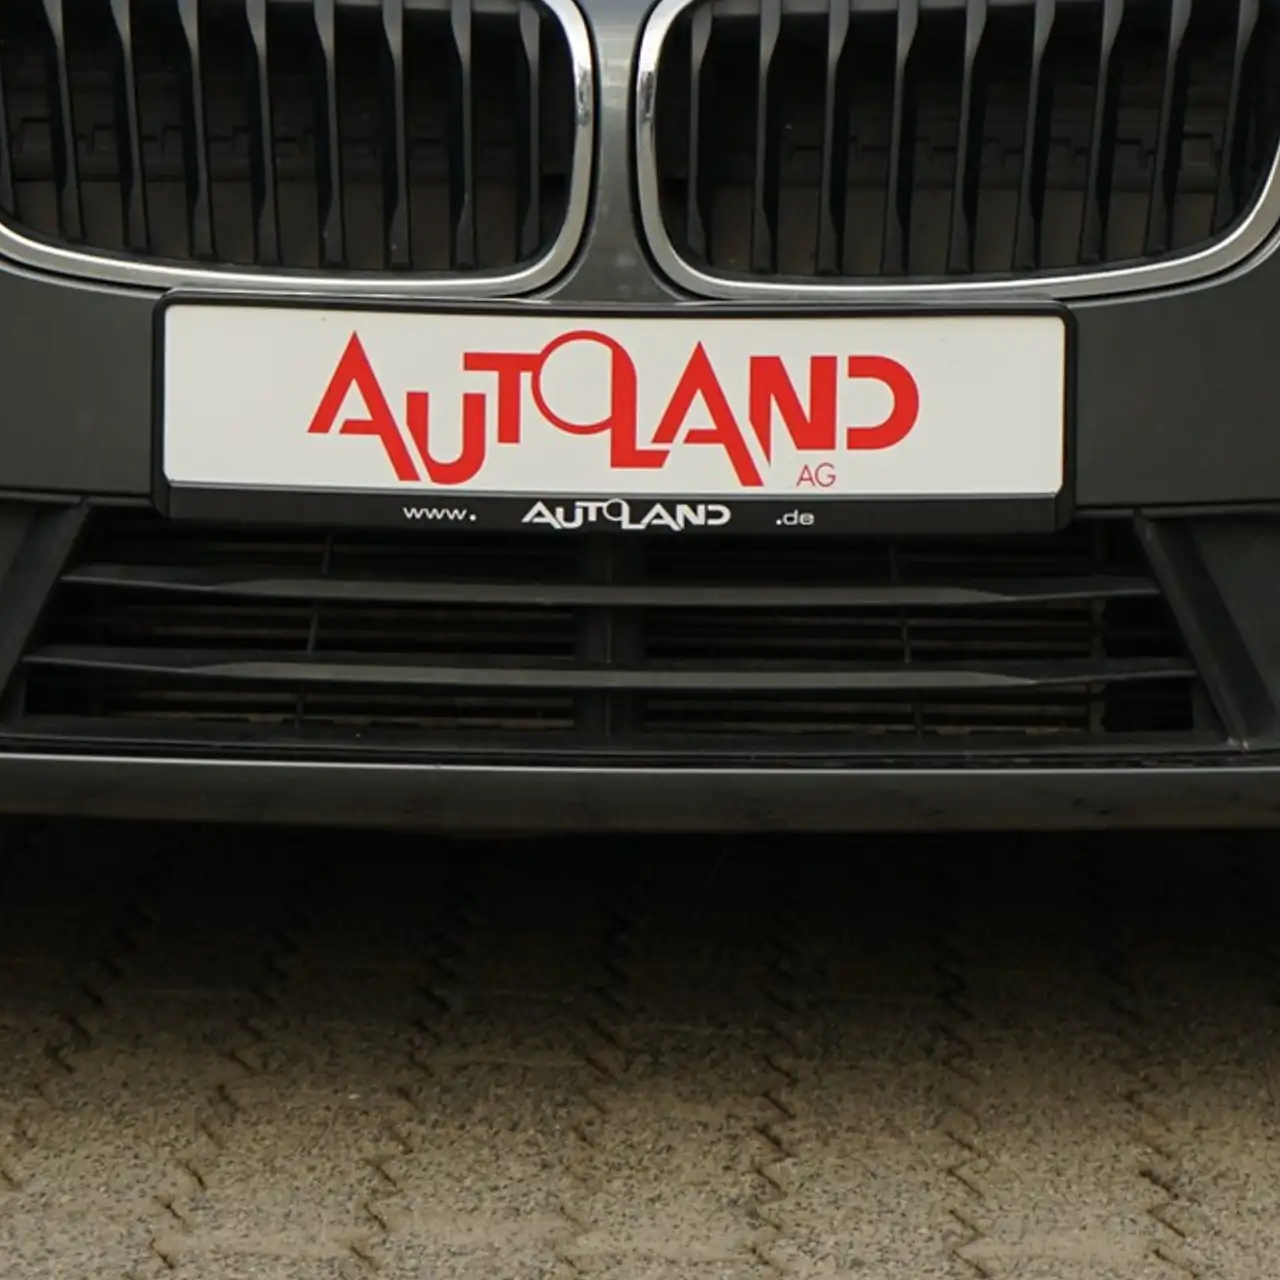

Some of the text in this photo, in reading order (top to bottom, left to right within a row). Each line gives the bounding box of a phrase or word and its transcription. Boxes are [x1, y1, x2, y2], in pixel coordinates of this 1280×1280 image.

[307, 329, 921, 488] AUTOLAND
[795, 462, 838, 488] AG
[402, 498, 816, 531] www. AUTOLAND .de
